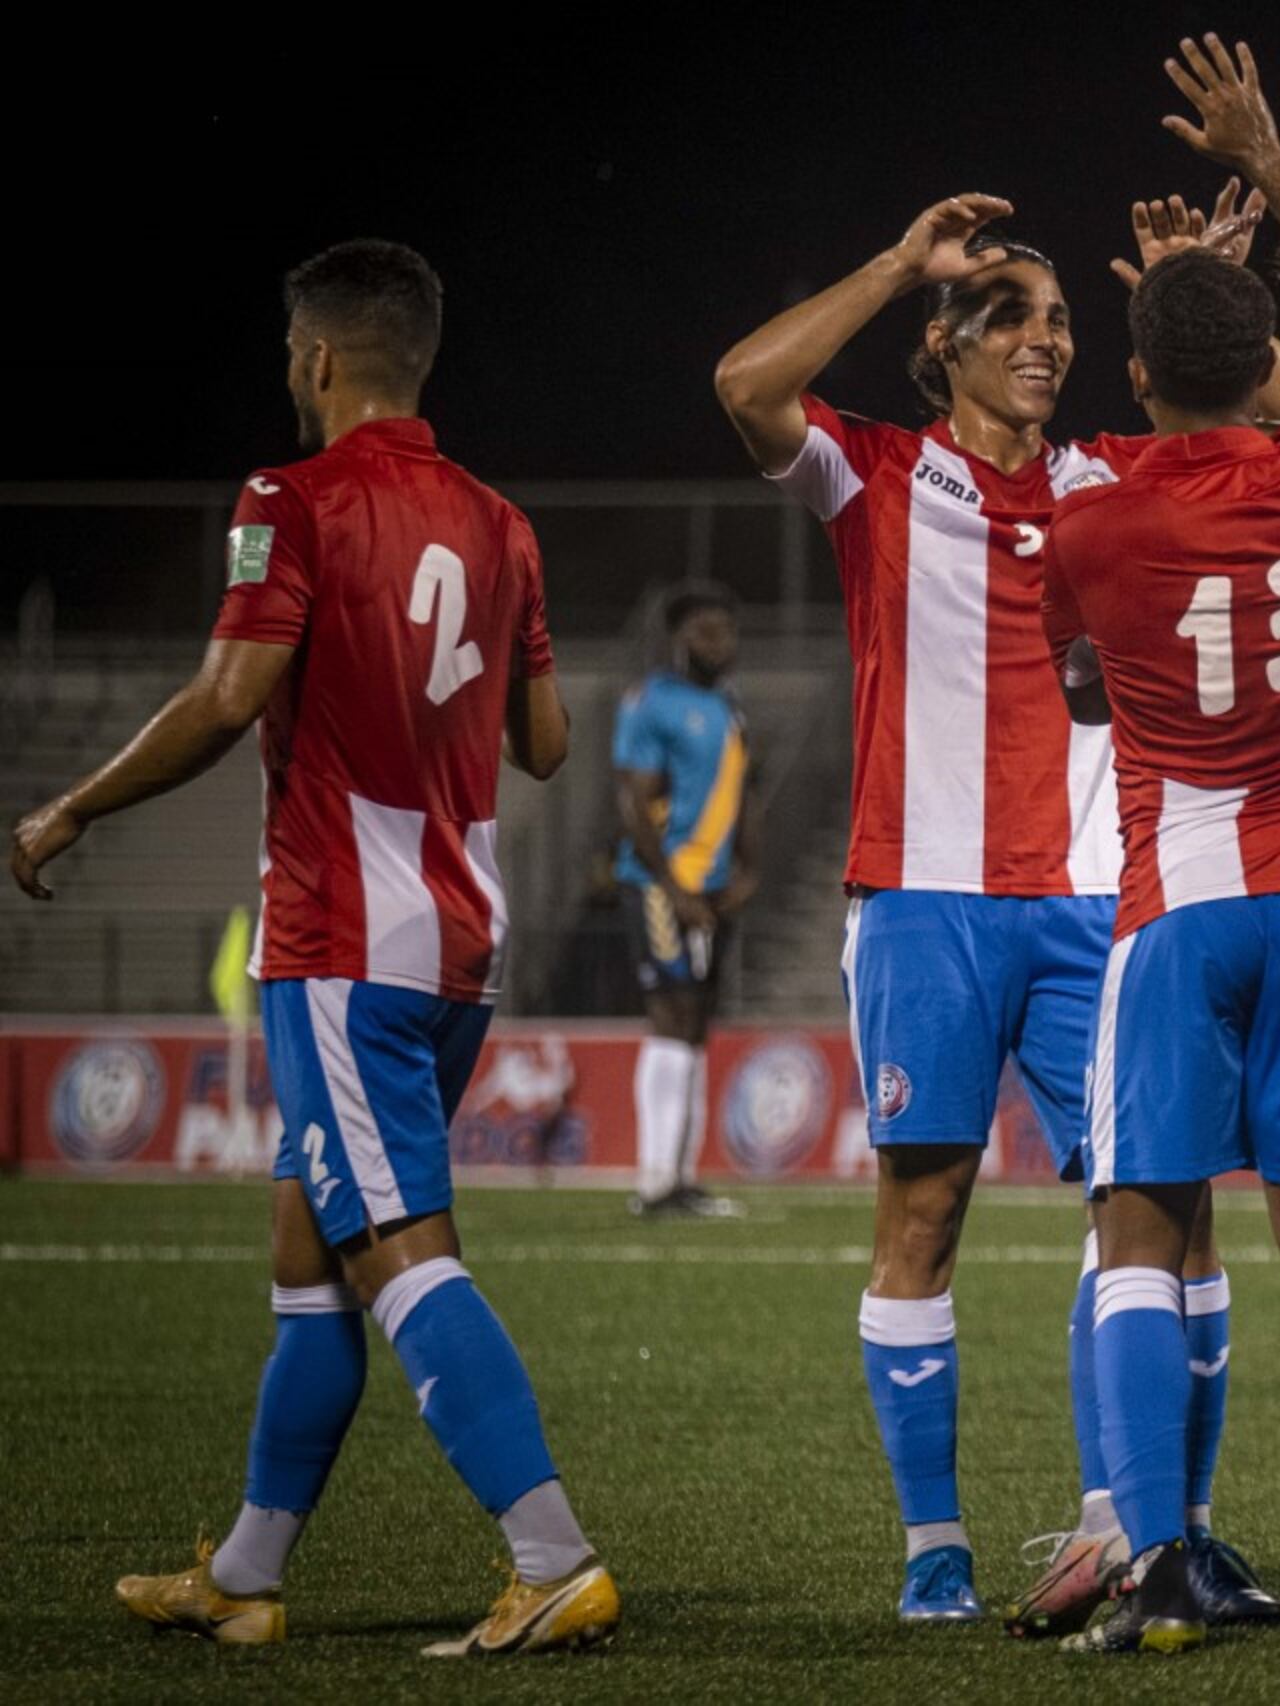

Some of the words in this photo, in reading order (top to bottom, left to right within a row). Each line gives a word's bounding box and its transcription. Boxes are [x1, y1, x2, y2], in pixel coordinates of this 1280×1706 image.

[914, 462, 980, 505] Joma
[408, 543, 485, 706] 2
[302, 1121, 330, 1185] 2
